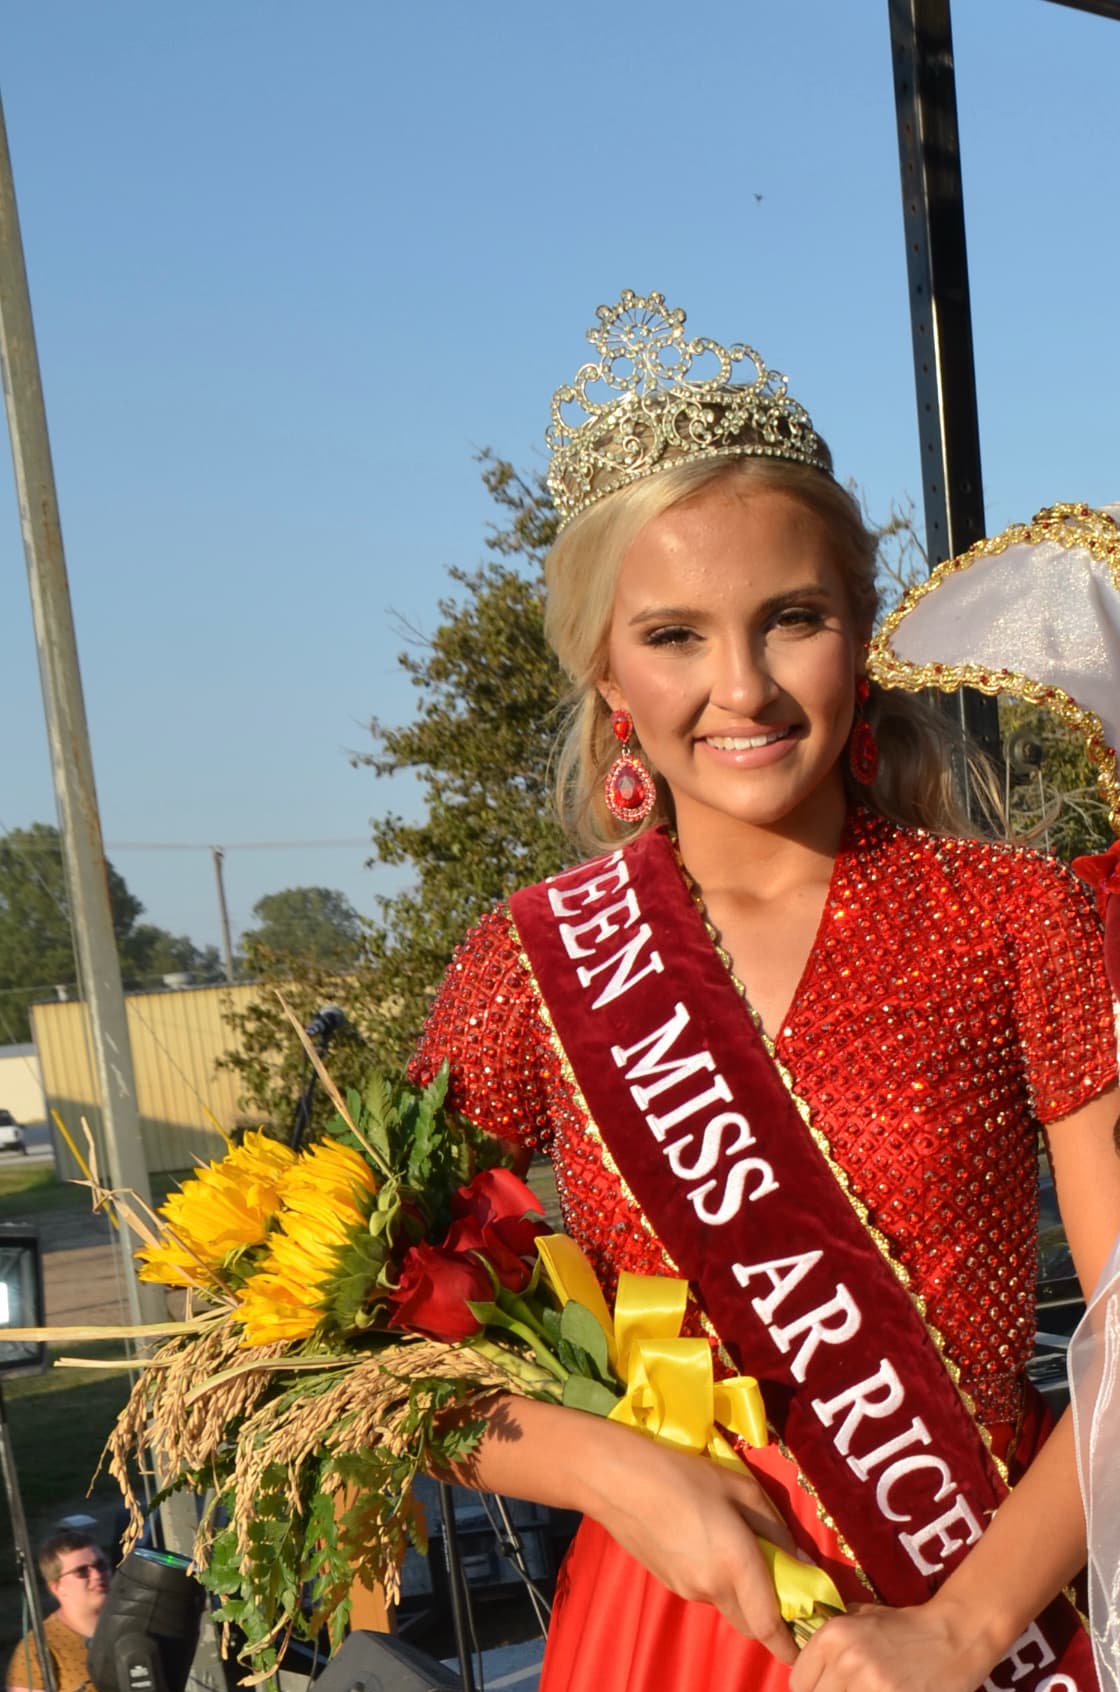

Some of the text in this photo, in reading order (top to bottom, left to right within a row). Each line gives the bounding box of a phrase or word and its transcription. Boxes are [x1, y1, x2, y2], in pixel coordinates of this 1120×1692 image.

[611, 1002, 779, 1225] MISS
[731, 1250, 862, 1383] AR
[811, 1358, 984, 1577] RICE
